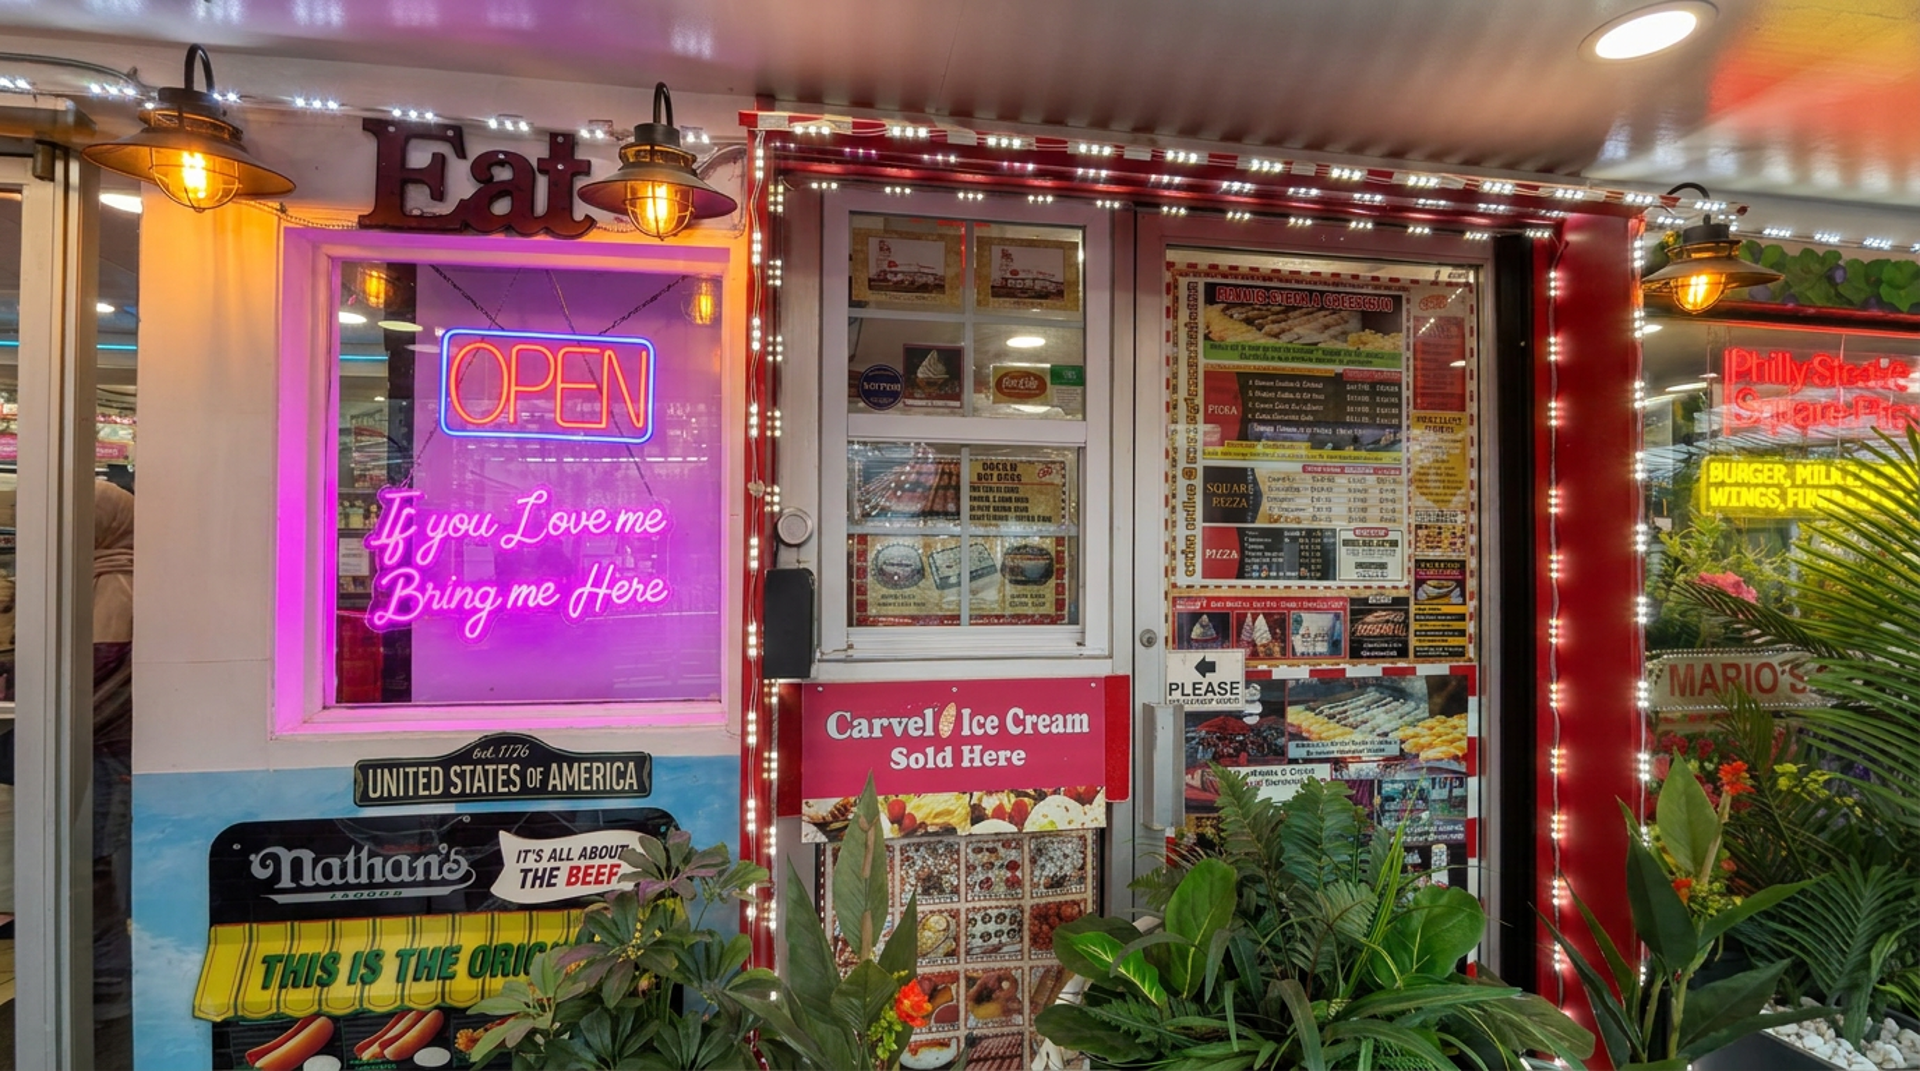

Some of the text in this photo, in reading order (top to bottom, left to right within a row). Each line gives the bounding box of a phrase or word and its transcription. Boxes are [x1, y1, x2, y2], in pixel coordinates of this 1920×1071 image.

[358, 117, 598, 240] Eat
[449, 341, 648, 429] OPEN
[1731, 347, 1809, 394] Philly
[1708, 462, 1792, 487] BURGER,
[1708, 486, 1787, 511] WINGS,
[371, 490, 422, 565] If
[416, 511, 498, 565] you
[501, 489, 610, 549] Love
[614, 507, 667, 535] me
[374, 562, 669, 640] Bring me Here
[1168, 681, 1240, 697] PLEASE
[1668, 661, 1808, 698] MARIO'S
[825, 706, 1090, 740] Carvel Ice Cream
[889, 744, 1027, 770] Sold Here
[367, 760, 638, 799] UNITED STATES OF AMERICA
[250, 843, 476, 888] Nathan's
[515, 843, 630, 865] IT'S ALL ABOUT
[518, 862, 622, 889] THE BEEF
[261, 952, 341, 991] THIS
[346, 948, 386, 987] IS
[395, 944, 463, 983] THE
